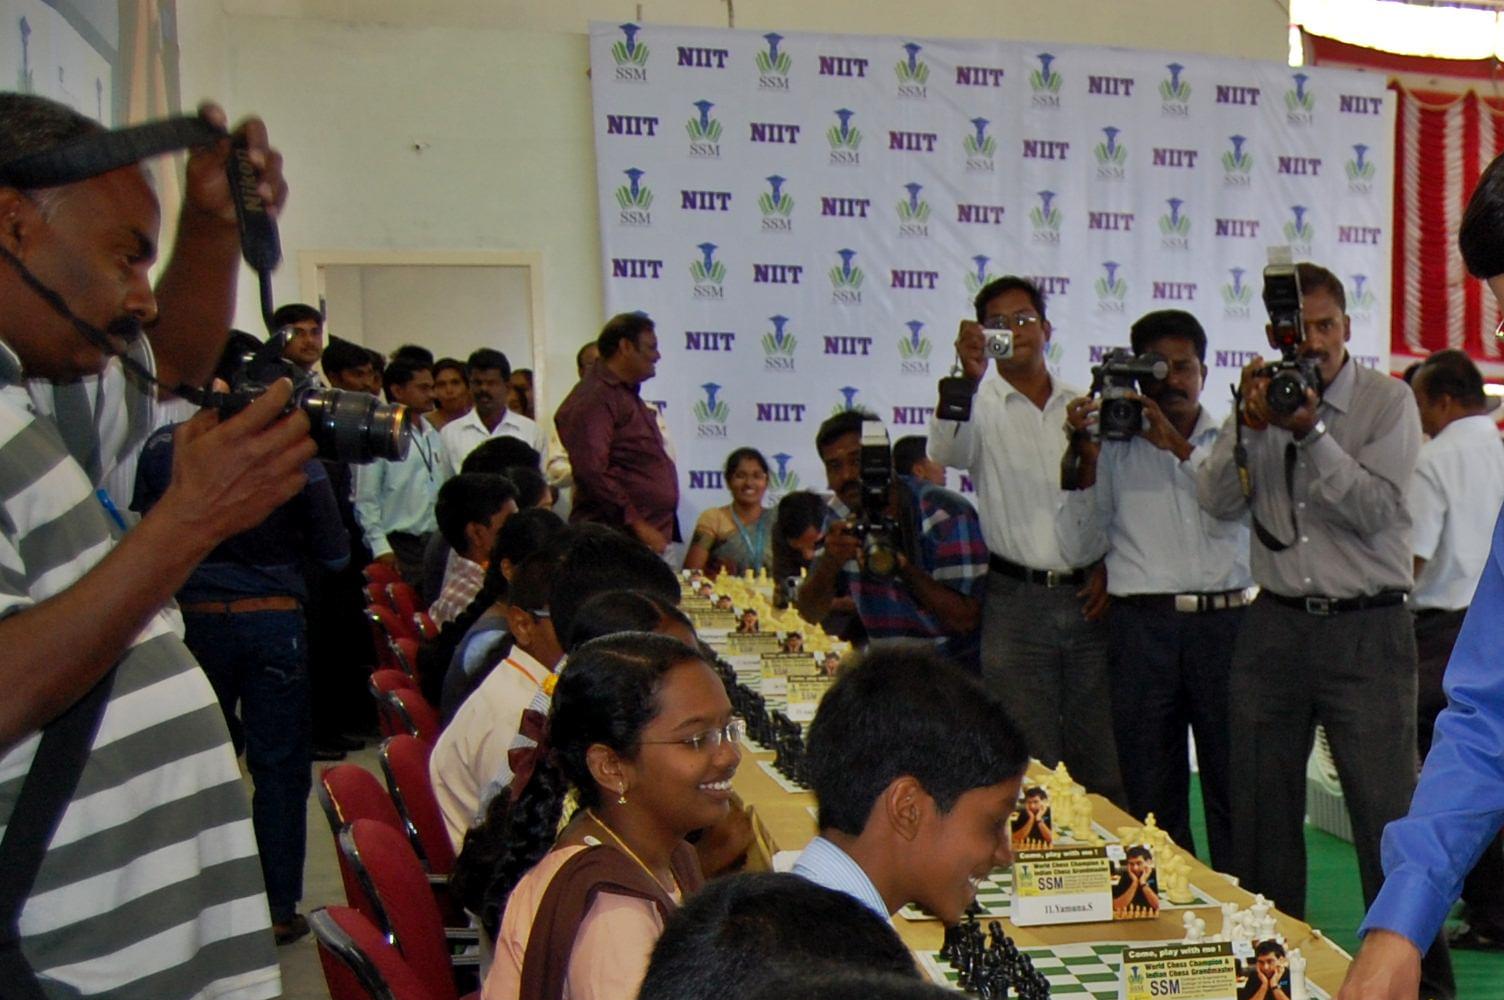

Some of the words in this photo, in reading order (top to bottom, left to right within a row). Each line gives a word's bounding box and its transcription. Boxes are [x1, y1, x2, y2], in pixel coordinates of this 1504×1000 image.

[677, 46, 729, 69] NIIT
[615, 67, 647, 81] SSM
[819, 56, 868, 78] NIIT
[759, 76, 790, 90] SSM
[956, 66, 1004, 88] NIIT
[897, 85, 927, 99] SSM
[1088, 76, 1134, 97] NIIT
[1031, 95, 1060, 107] SSM
[1216, 85, 1260, 106] NIIT
[1161, 104, 1189, 117] SSM
[1340, 95, 1382, 115] NIIT
[607, 114, 658, 136] NIIT
[1287, 112, 1313, 124] SSM
[750, 122, 800, 145] NIIT
[889, 131, 937, 152] NIIT
[689, 143, 720, 157] SSM
[830, 151, 860, 164] SSM
[1023, 140, 1070, 160] NIIT
[1152, 147, 1198, 168] NIIT
[966, 159, 995, 172] SSM
[1096, 167, 1125, 180] SSM
[1278, 156, 1322, 176] NIIT
[1224, 175, 1251, 187] SSM
[1348, 182, 1373, 194] SSM
[681, 190, 731, 211] NIIT
[821, 197, 870, 218] NIIT
[619, 212, 651, 225] SSM
[957, 204, 1005, 225] NIIT
[1088, 211, 1134, 232] NIIT
[761, 218, 792, 232] SSM
[900, 224, 929, 237] SSM
[1215, 219, 1260, 239] NIIT
[1032, 231, 1060, 243] SSM
[1338, 225, 1382, 245] NIIT
[1161, 238, 1189, 250] SSM
[612, 258, 662, 279] NIIT
[753, 263, 802, 285] NIIT
[891, 270, 938, 290] NIIT
[693, 285, 724, 298] SSM
[832, 290, 861, 303] SSM
[1152, 281, 1197, 300] NIIT
[1098, 301, 1125, 313] SSM
[1224, 307, 1250, 319] SSM
[685, 331, 735, 352] NIIT
[823, 335, 872, 356] NIIT
[765, 357, 795, 370] SSM
[901, 361, 929, 374] SSM
[756, 403, 806, 422] NIIT
[697, 425, 727, 438] SSM
[689, 470, 724, 489] NII
[1038, 877, 1063, 890] SSM
[1159, 948, 1179, 957] play
[1180, 946, 1200, 954] with
[1151, 979, 1180, 996] SSM
